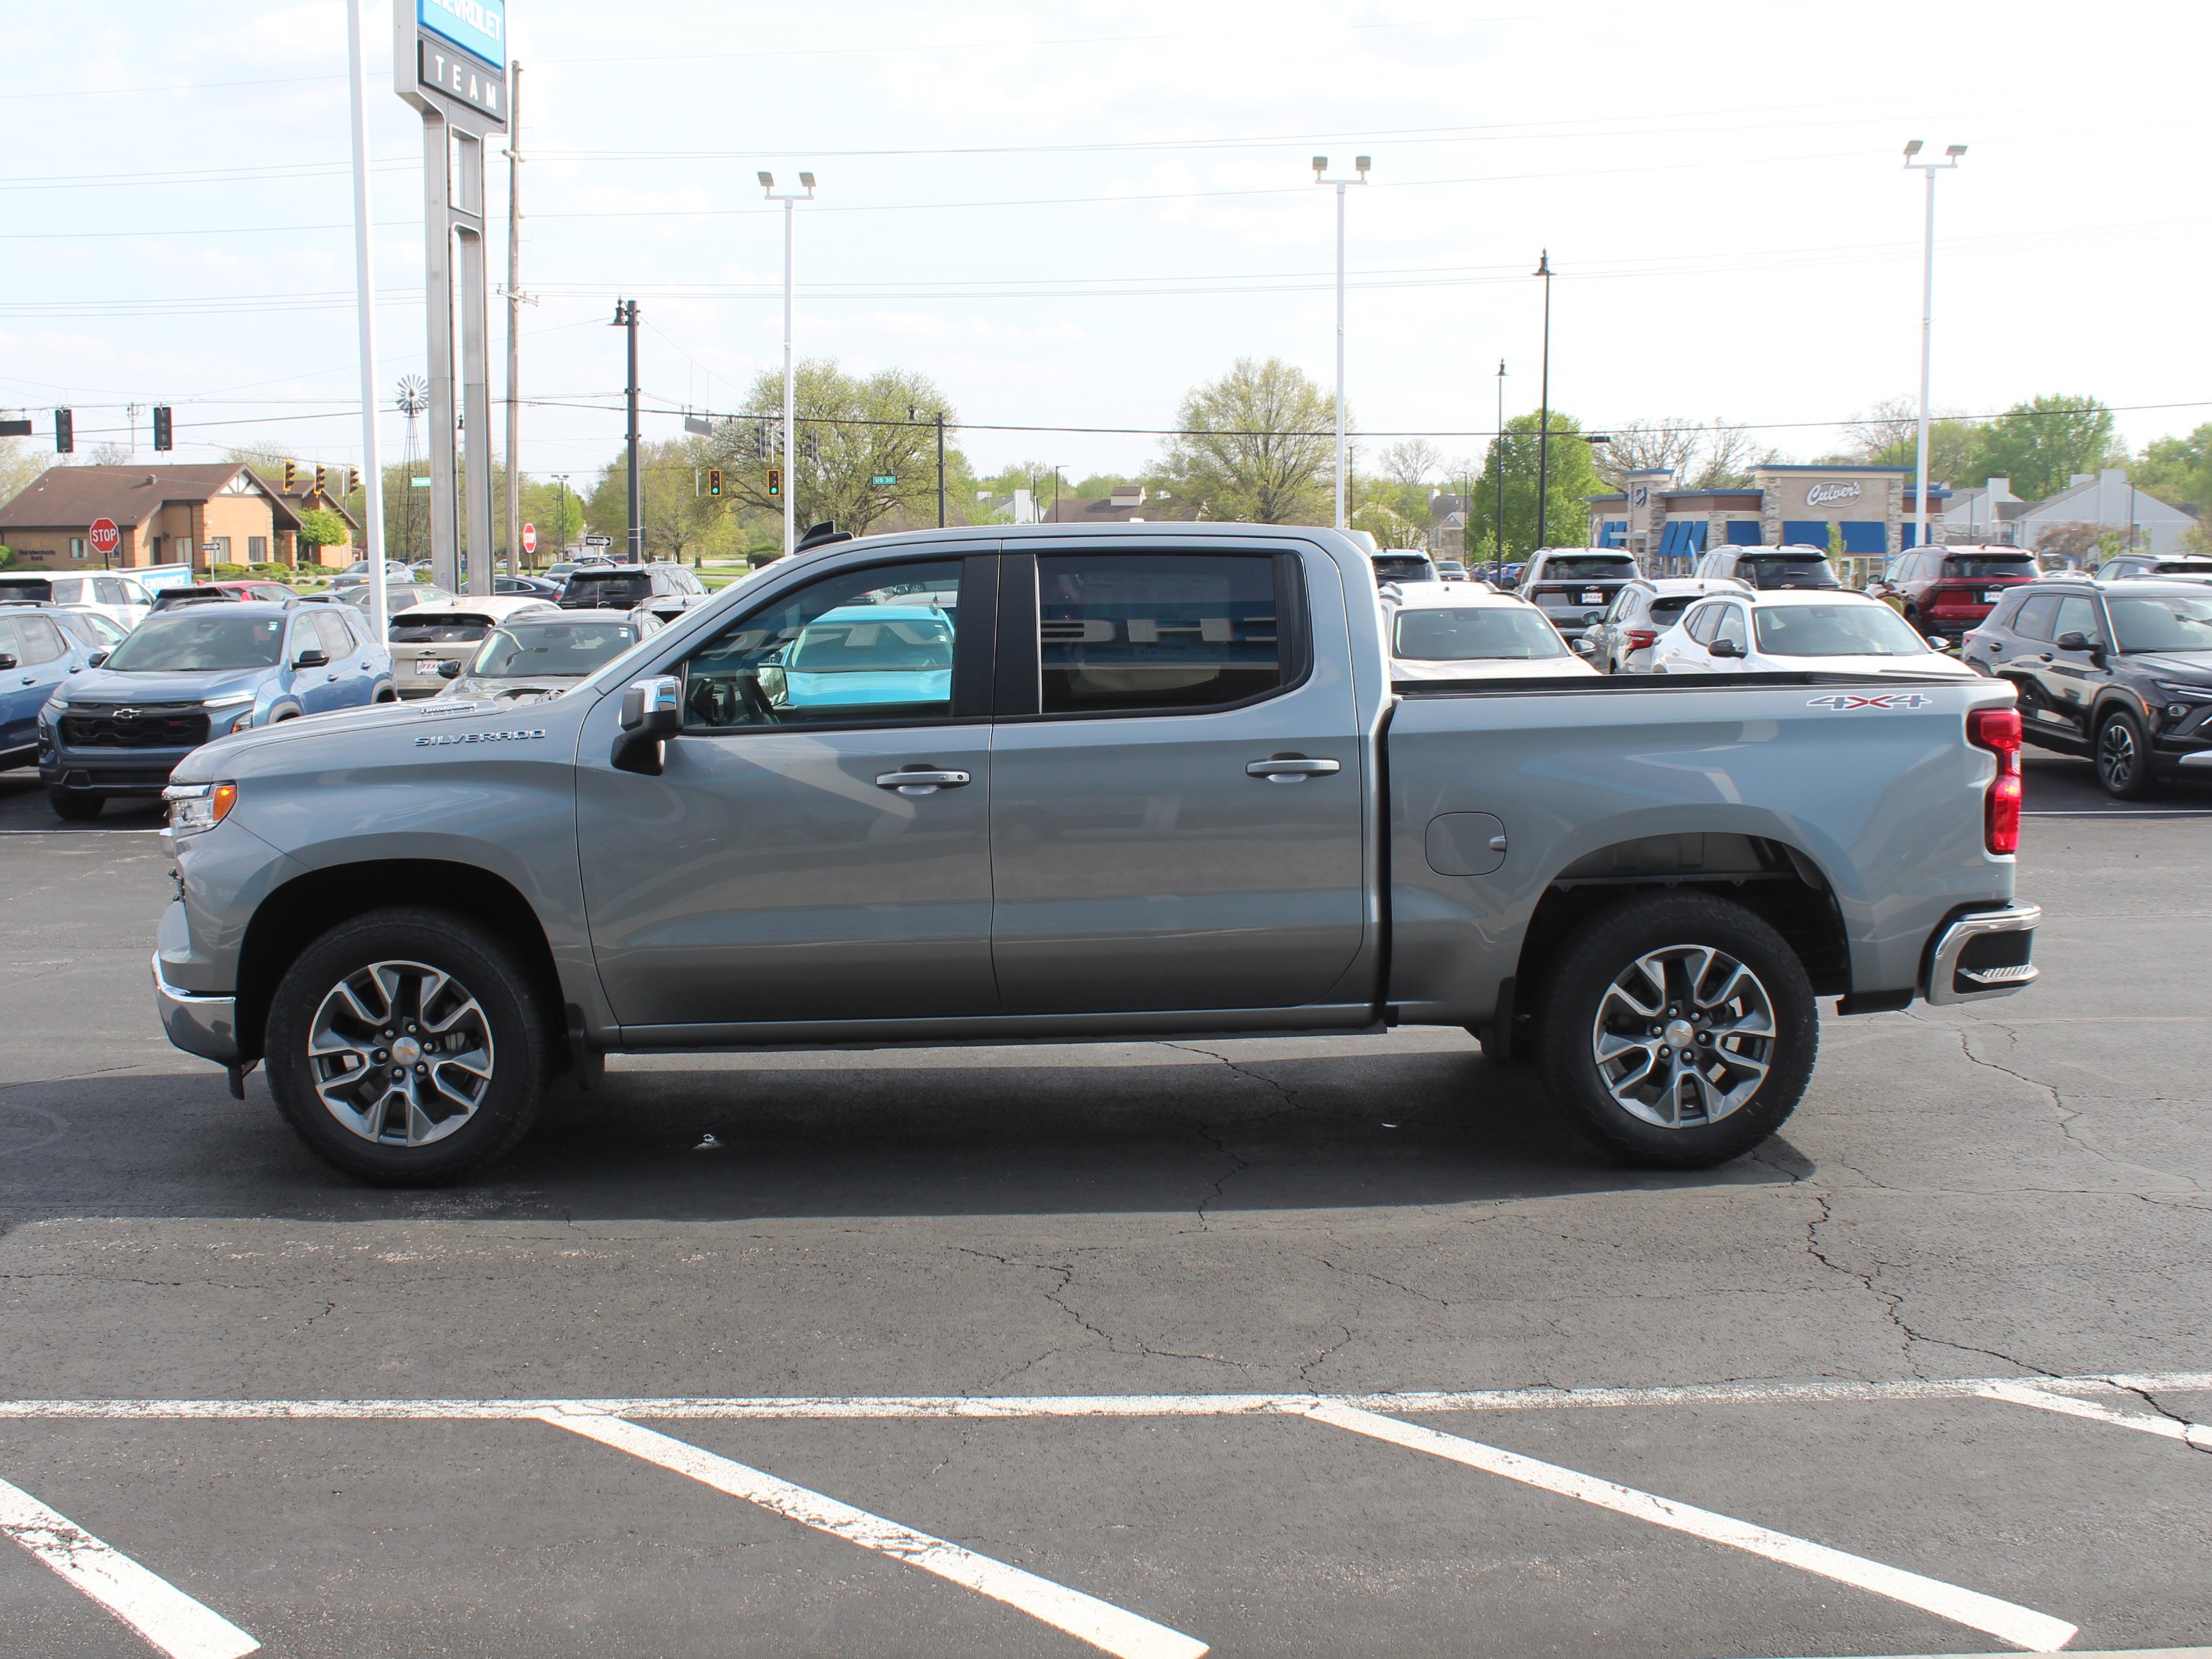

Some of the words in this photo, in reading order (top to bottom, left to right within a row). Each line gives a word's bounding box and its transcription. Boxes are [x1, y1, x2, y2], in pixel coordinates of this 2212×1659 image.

[429, 0, 501, 42] EVROLET
[435, 54, 496, 109] TEAM
[1806, 481, 1861, 506] Culver's
[92, 528, 117, 542] STOP
[524, 533, 535, 544] STOP
[145, 574, 186, 590] ENTRANCE
[1807, 693, 1933, 711] 4X4
[415, 729, 546, 746] SILVERADO
